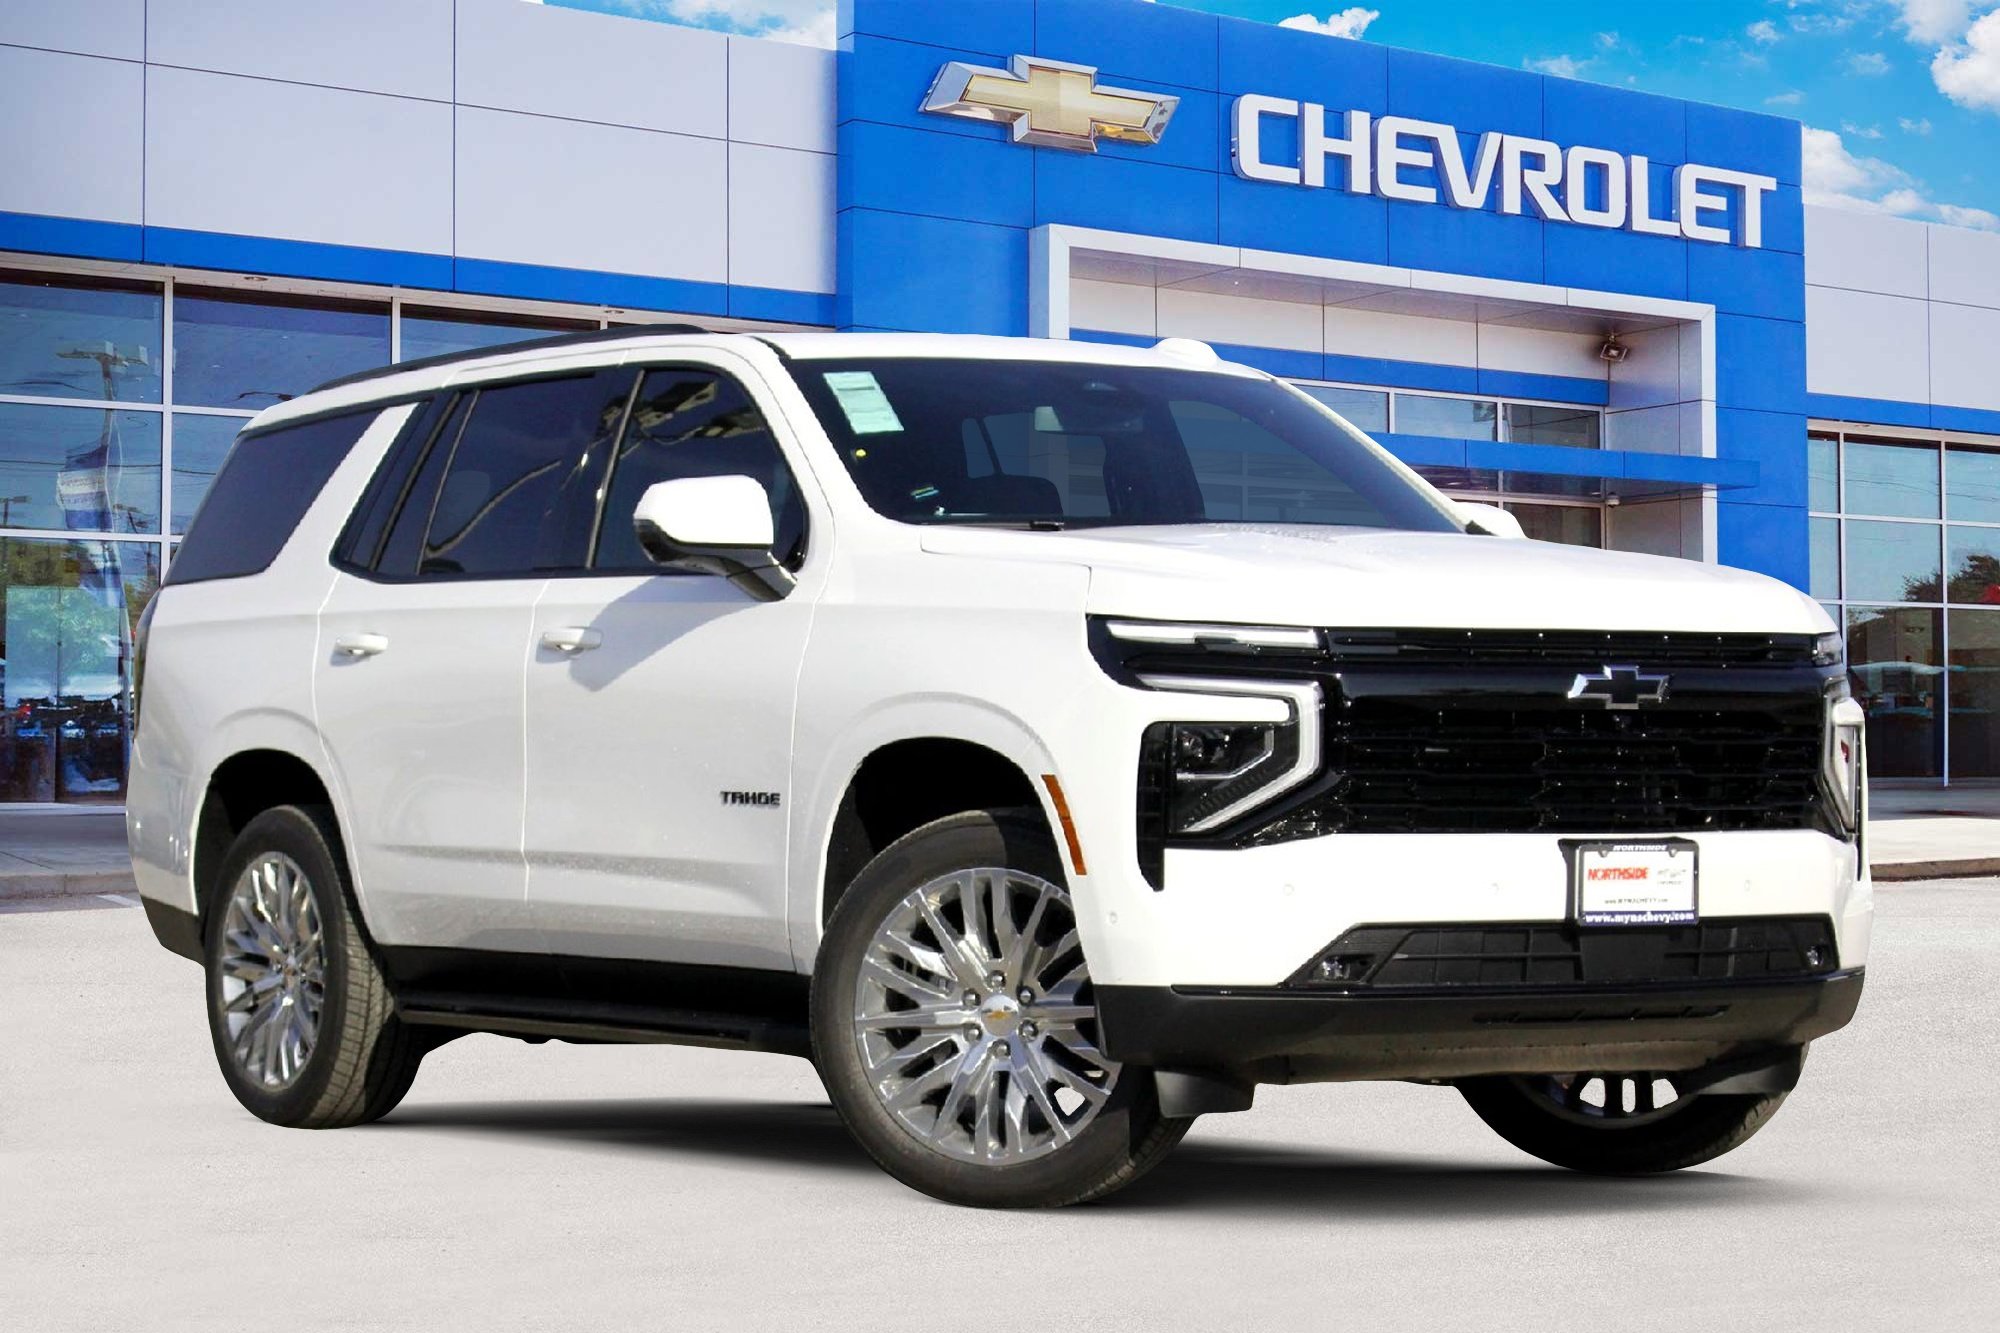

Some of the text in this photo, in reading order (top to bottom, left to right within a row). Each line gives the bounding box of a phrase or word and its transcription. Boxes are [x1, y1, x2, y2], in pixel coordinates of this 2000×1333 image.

[1231, 93, 1777, 248] CHEVROLET
[720, 791, 781, 806] TAHOE
[1587, 867, 1649, 881] NORTHSIDE
